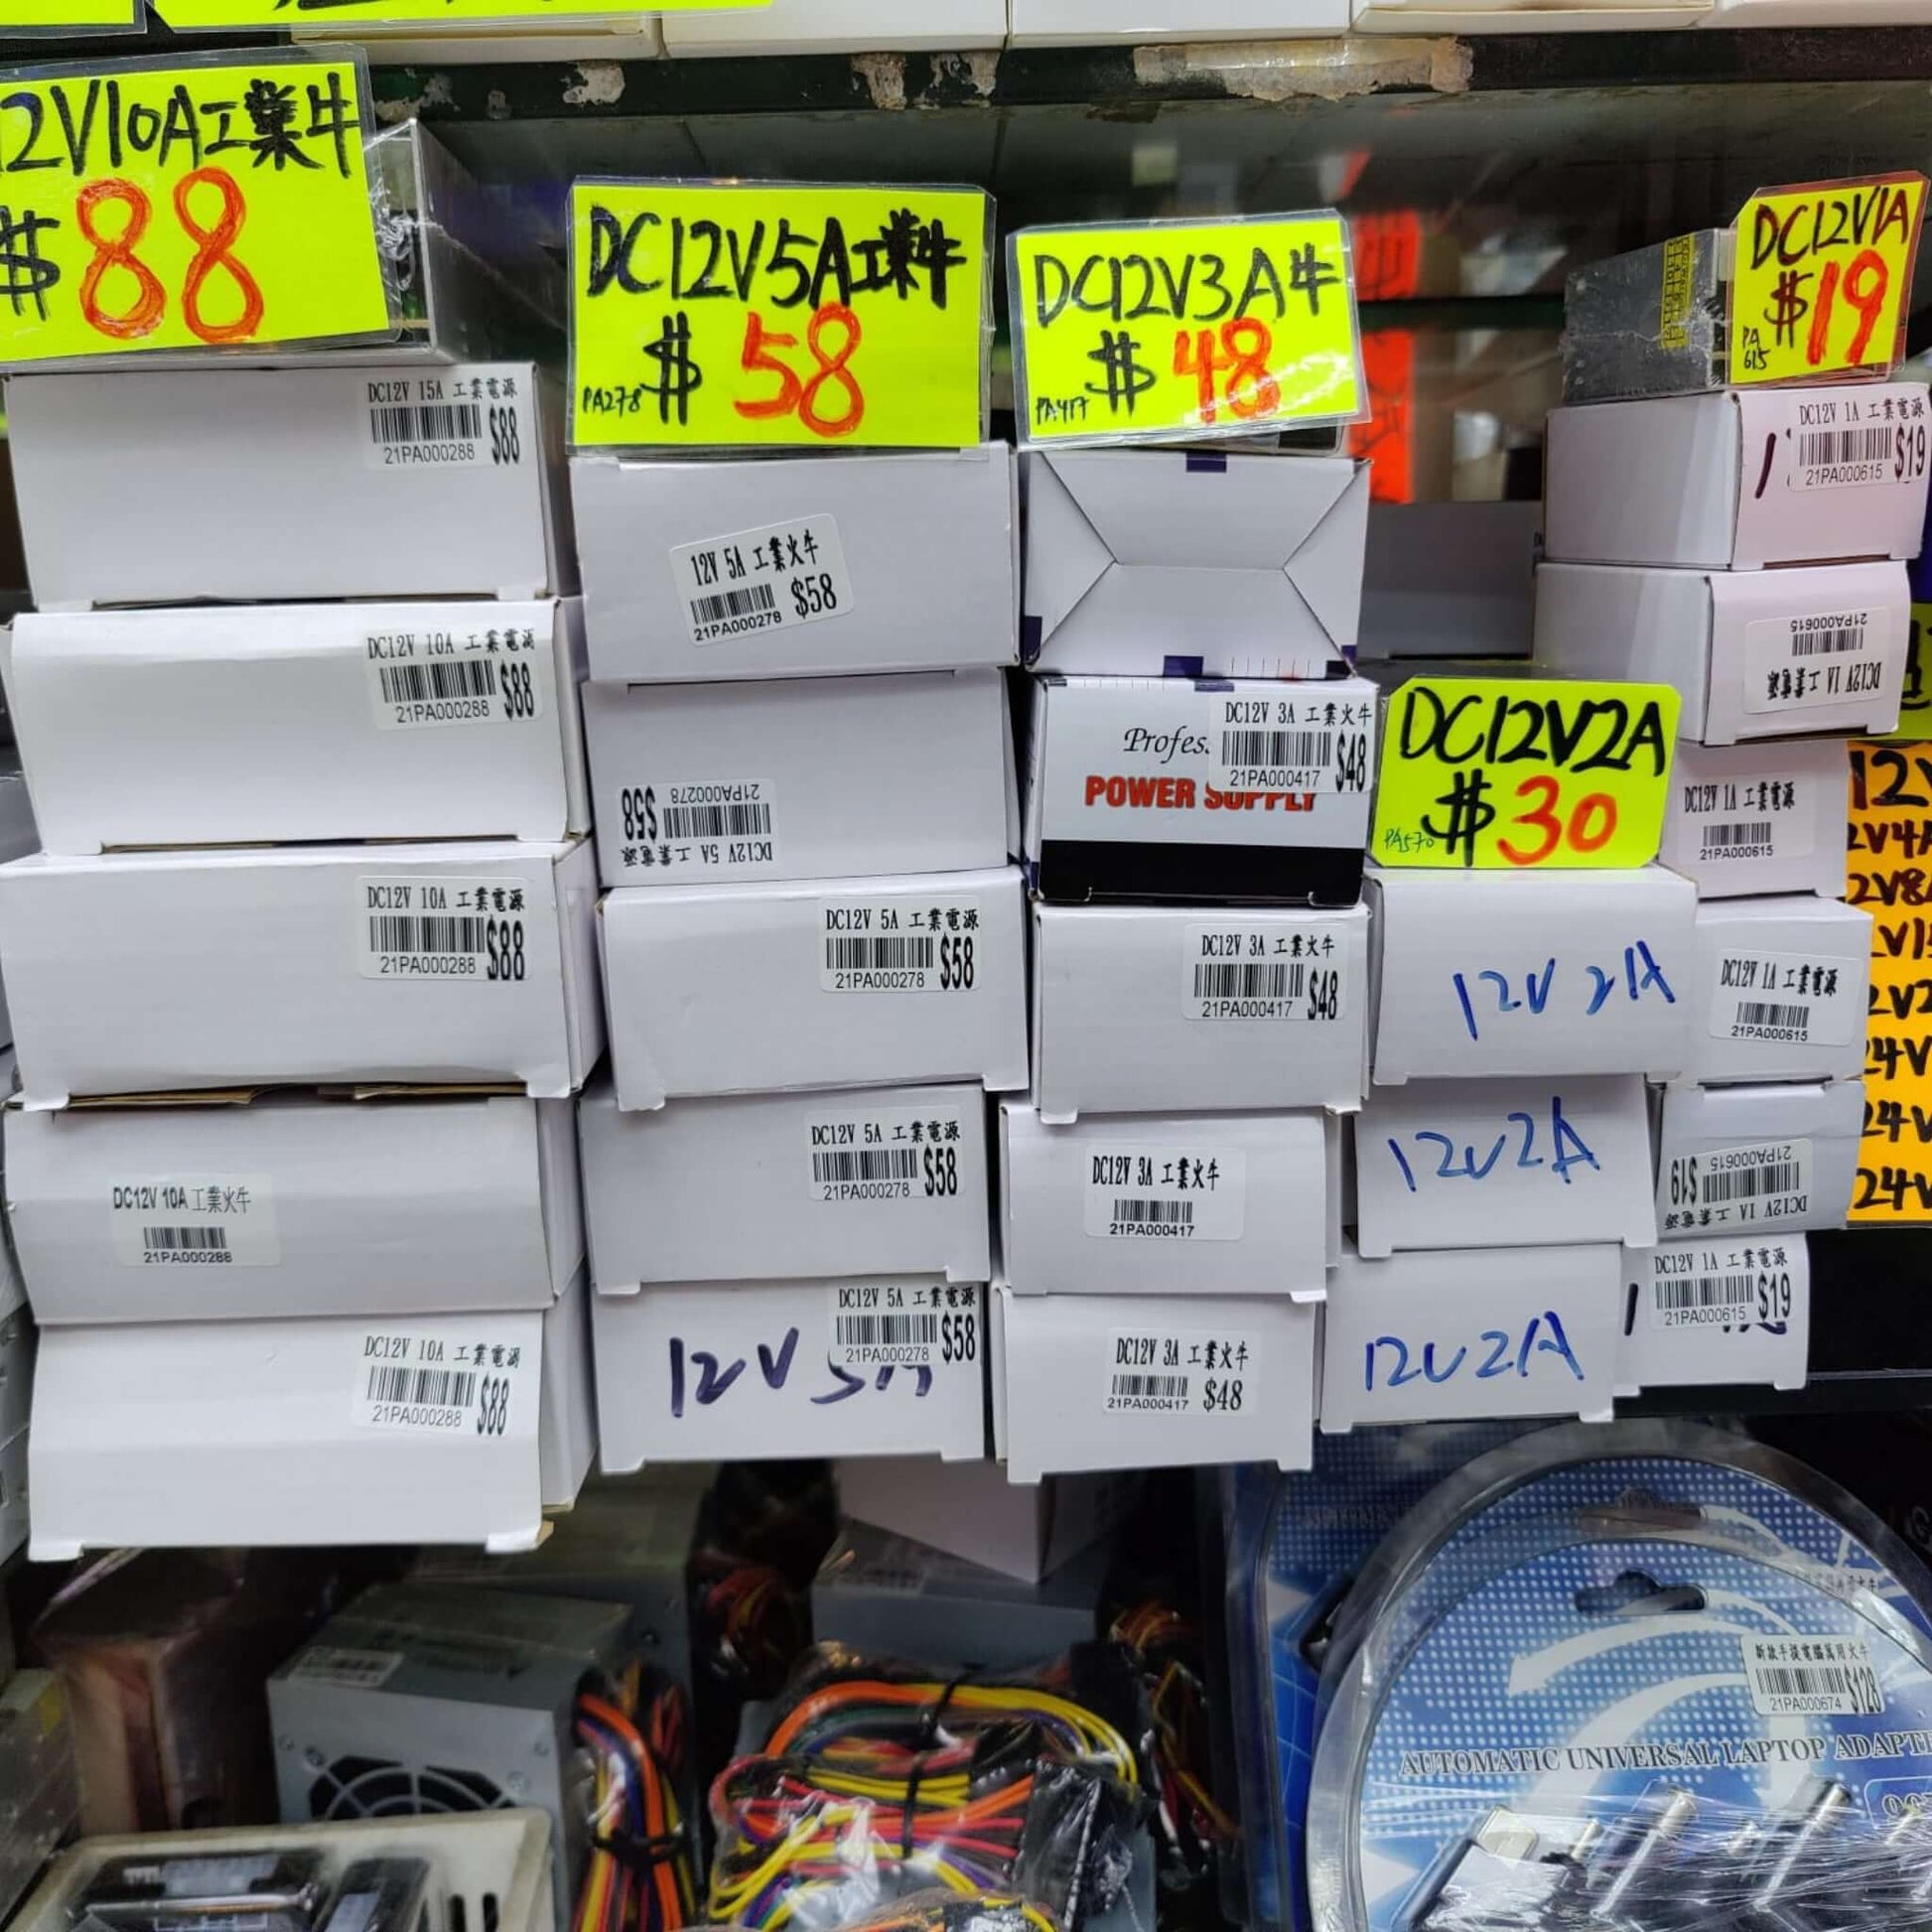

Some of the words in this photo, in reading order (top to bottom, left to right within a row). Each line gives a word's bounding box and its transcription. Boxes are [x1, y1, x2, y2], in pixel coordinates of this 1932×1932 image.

[0, 71, 359, 179] 2V10A工業牛
[1751, 186, 1910, 270] DC12V1A
[1742, 326, 1761, 348] PA
[1743, 348, 1767, 370] 615
[368, 381, 409, 402] DC12V
[419, 380, 444, 401] 15A
[453, 377, 517, 399] 工業電源
[582, 385, 642, 418] PA278
[1035, 397, 1090, 426] PA417
[1799, 402, 1837, 425] DC12V
[1845, 400, 1860, 422] 1A
[1867, 397, 1925, 421] 工業電源
[489, 404, 519, 465] $88
[384, 444, 475, 465] 21PA000288
[1894, 423, 1926, 482] $19
[1806, 463, 1883, 485] 21PA000615
[691, 551, 719, 586] 12V
[724, 545, 747, 579] 5A
[753, 528, 819, 573] 工業火牛
[790, 573, 837, 620] $58
[694, 611, 782, 641] 21PA000278
[1790, 613, 1867, 632] 21PA000615
[367, 633, 415, 659] DC12V
[427, 632, 454, 655] 10A
[500, 659, 533, 721] $88
[1828, 665, 1842, 695] 1A
[1846, 661, 1882, 693] DC12V
[396, 700, 489, 723] 21PA000288
[1225, 702, 1270, 724] DC12V
[1278, 702, 1295, 724] 3A
[1305, 703, 1372, 727] 工業火牛
[1123, 726, 1209, 763] Profes
[1400, 686, 1667, 777] DC12V2A
[1335, 729, 1366, 792] $48
[1084, 775, 1196, 808] POWER
[1229, 769, 1320, 787] 21PA000417
[670, 783, 759, 804] 21PA000278
[1685, 784, 1718, 813] DC12V
[1724, 783, 1736, 811] 1A
[621, 785, 657, 844] $58
[701, 844, 719, 864] 5A
[729, 842, 773, 864] DC12V
[1384, 828, 1435, 855] PA570
[1700, 845, 1773, 861] 21PA000615
[367, 886, 411, 908] DC12V
[421, 887, 447, 909] 10A
[457, 887, 524, 911] 工業電源
[1848, 868, 1932, 905] 2V8
[826, 908, 872, 930] DC12V
[881, 908, 898, 930] 5A
[908, 907, 980, 931] 工業電源
[486, 914, 524, 981] $88
[1201, 934, 1242, 956] DC12V
[1249, 934, 1265, 956] 3A
[1273, 933, 1334, 958] 工業火牛
[380, 955, 476, 974] 21PA000288
[940, 932, 974, 991] $58
[1721, 958, 1758, 988] DC12V
[1761, 962, 1776, 990] 1A
[835, 971, 924, 989] 21PA000278
[1308, 966, 1338, 1021] $48
[1202, 1001, 1293, 1018] 21PA000417
[811, 1124, 855, 1146] DC12V
[865, 1123, 882, 1143] 5A
[891, 1120, 961, 1144] 工業電源
[923, 1144, 957, 1196] $58
[1711, 1146, 1791, 1172] 21PA000615
[1092, 1156, 1132, 1185] DC12V
[1138, 1157, 1153, 1186] 3A
[1161, 1157, 1219, 1191] 工業火牛
[1671, 1156, 1698, 1207] $19
[113, 1186, 157, 1209] DC12V
[163, 1186, 189, 1209] 10A
[190, 1185, 251, 1213] 工業火牛
[823, 1181, 910, 1200] 21PA000278
[1739, 1203, 1754, 1221] 1A
[1764, 1195, 1808, 1217] DC12V
[1109, 1223, 1194, 1237] 21PA000417
[143, 1251, 232, 1264] 21PA000288
[1654, 1253, 1694, 1275] DC12V
[1703, 1252, 1719, 1271] 1A
[1726, 1247, 1787, 1269] 工業電源
[839, 1288, 879, 1309] DC12V
[887, 1288, 904, 1308] 5A
[912, 1287, 976, 1308] 工業電源
[1757, 1270, 1791, 1321] $19
[1664, 1307, 1746, 1326] 21PA000615
[363, 1335, 411, 1358] DC12V
[419, 1339, 444, 1361] 10A
[941, 1311, 976, 1364] $58
[846, 1346, 929, 1363] 21PA000278
[1116, 1337, 1158, 1365] DC12V
[1164, 1338, 1179, 1366] 3A
[1186, 1340, 1249, 1371] 工業火牛
[478, 1371, 509, 1436] $88
[1107, 1397, 1189, 1411] 21PA000417
[1202, 1377, 1243, 1413] $48
[372, 1405, 462, 1427] 21PA000288
[1845, 1663, 1881, 1713] $128
[1769, 1696, 1843, 1712] 21PA000674
[1400, 1746, 1561, 1777] AUTOMATIC
[1567, 1740, 1722, 1771] UNIVERSAL
[1724, 1735, 1826, 1763] LAPTOP
[1835, 1730, 1932, 1760] ADAPT
